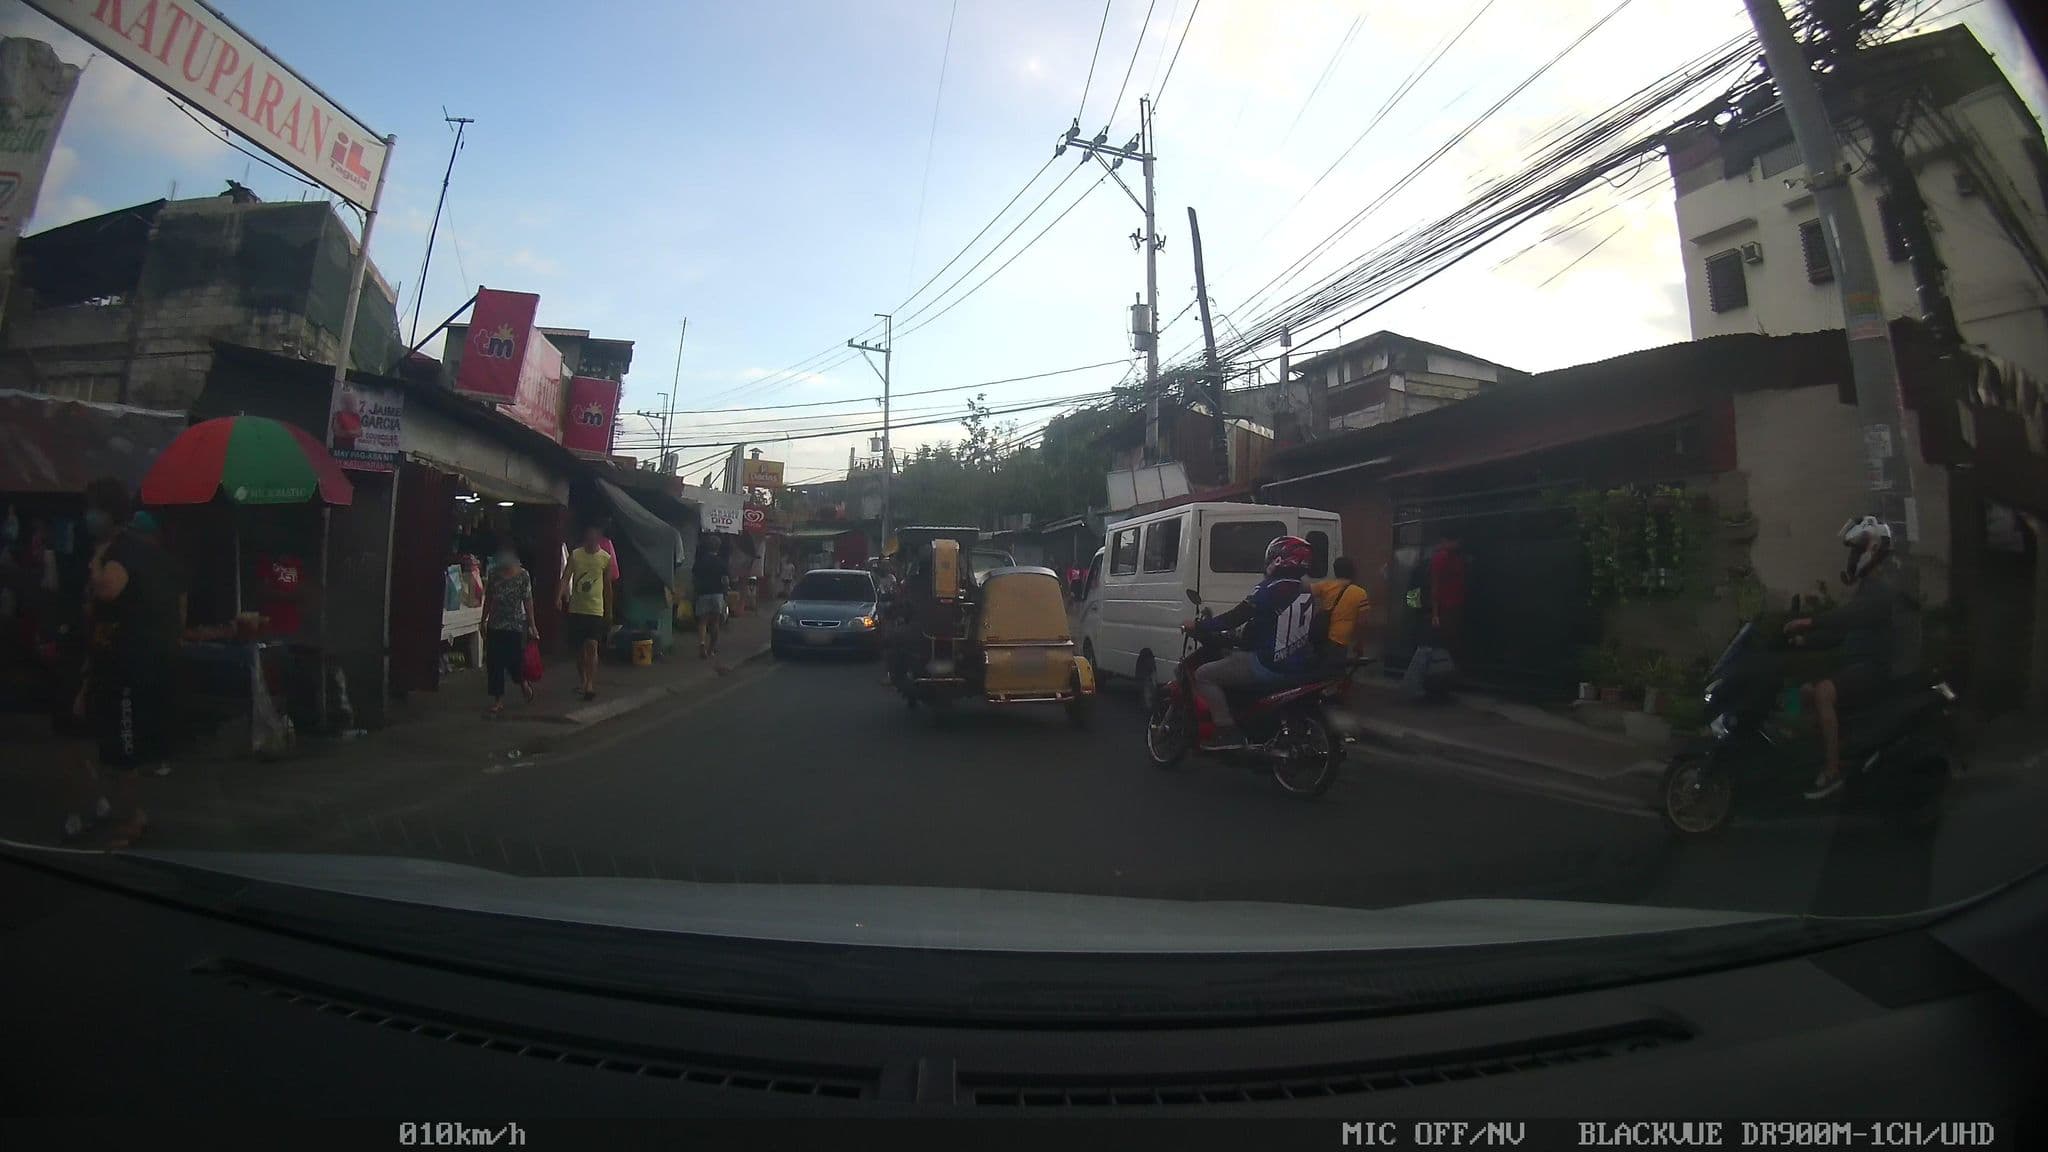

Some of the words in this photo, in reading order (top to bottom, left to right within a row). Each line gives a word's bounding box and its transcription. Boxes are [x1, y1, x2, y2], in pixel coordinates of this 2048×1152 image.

[90, 0, 333, 165] KATUPARAN
[329, 158, 369, 192] Taguig
[474, 328, 516, 361] tm
[369, 404, 402, 417] JAIME
[571, 403, 604, 427] tm
[361, 415, 401, 431] GARCIA
[711, 517, 733, 525] DITO
